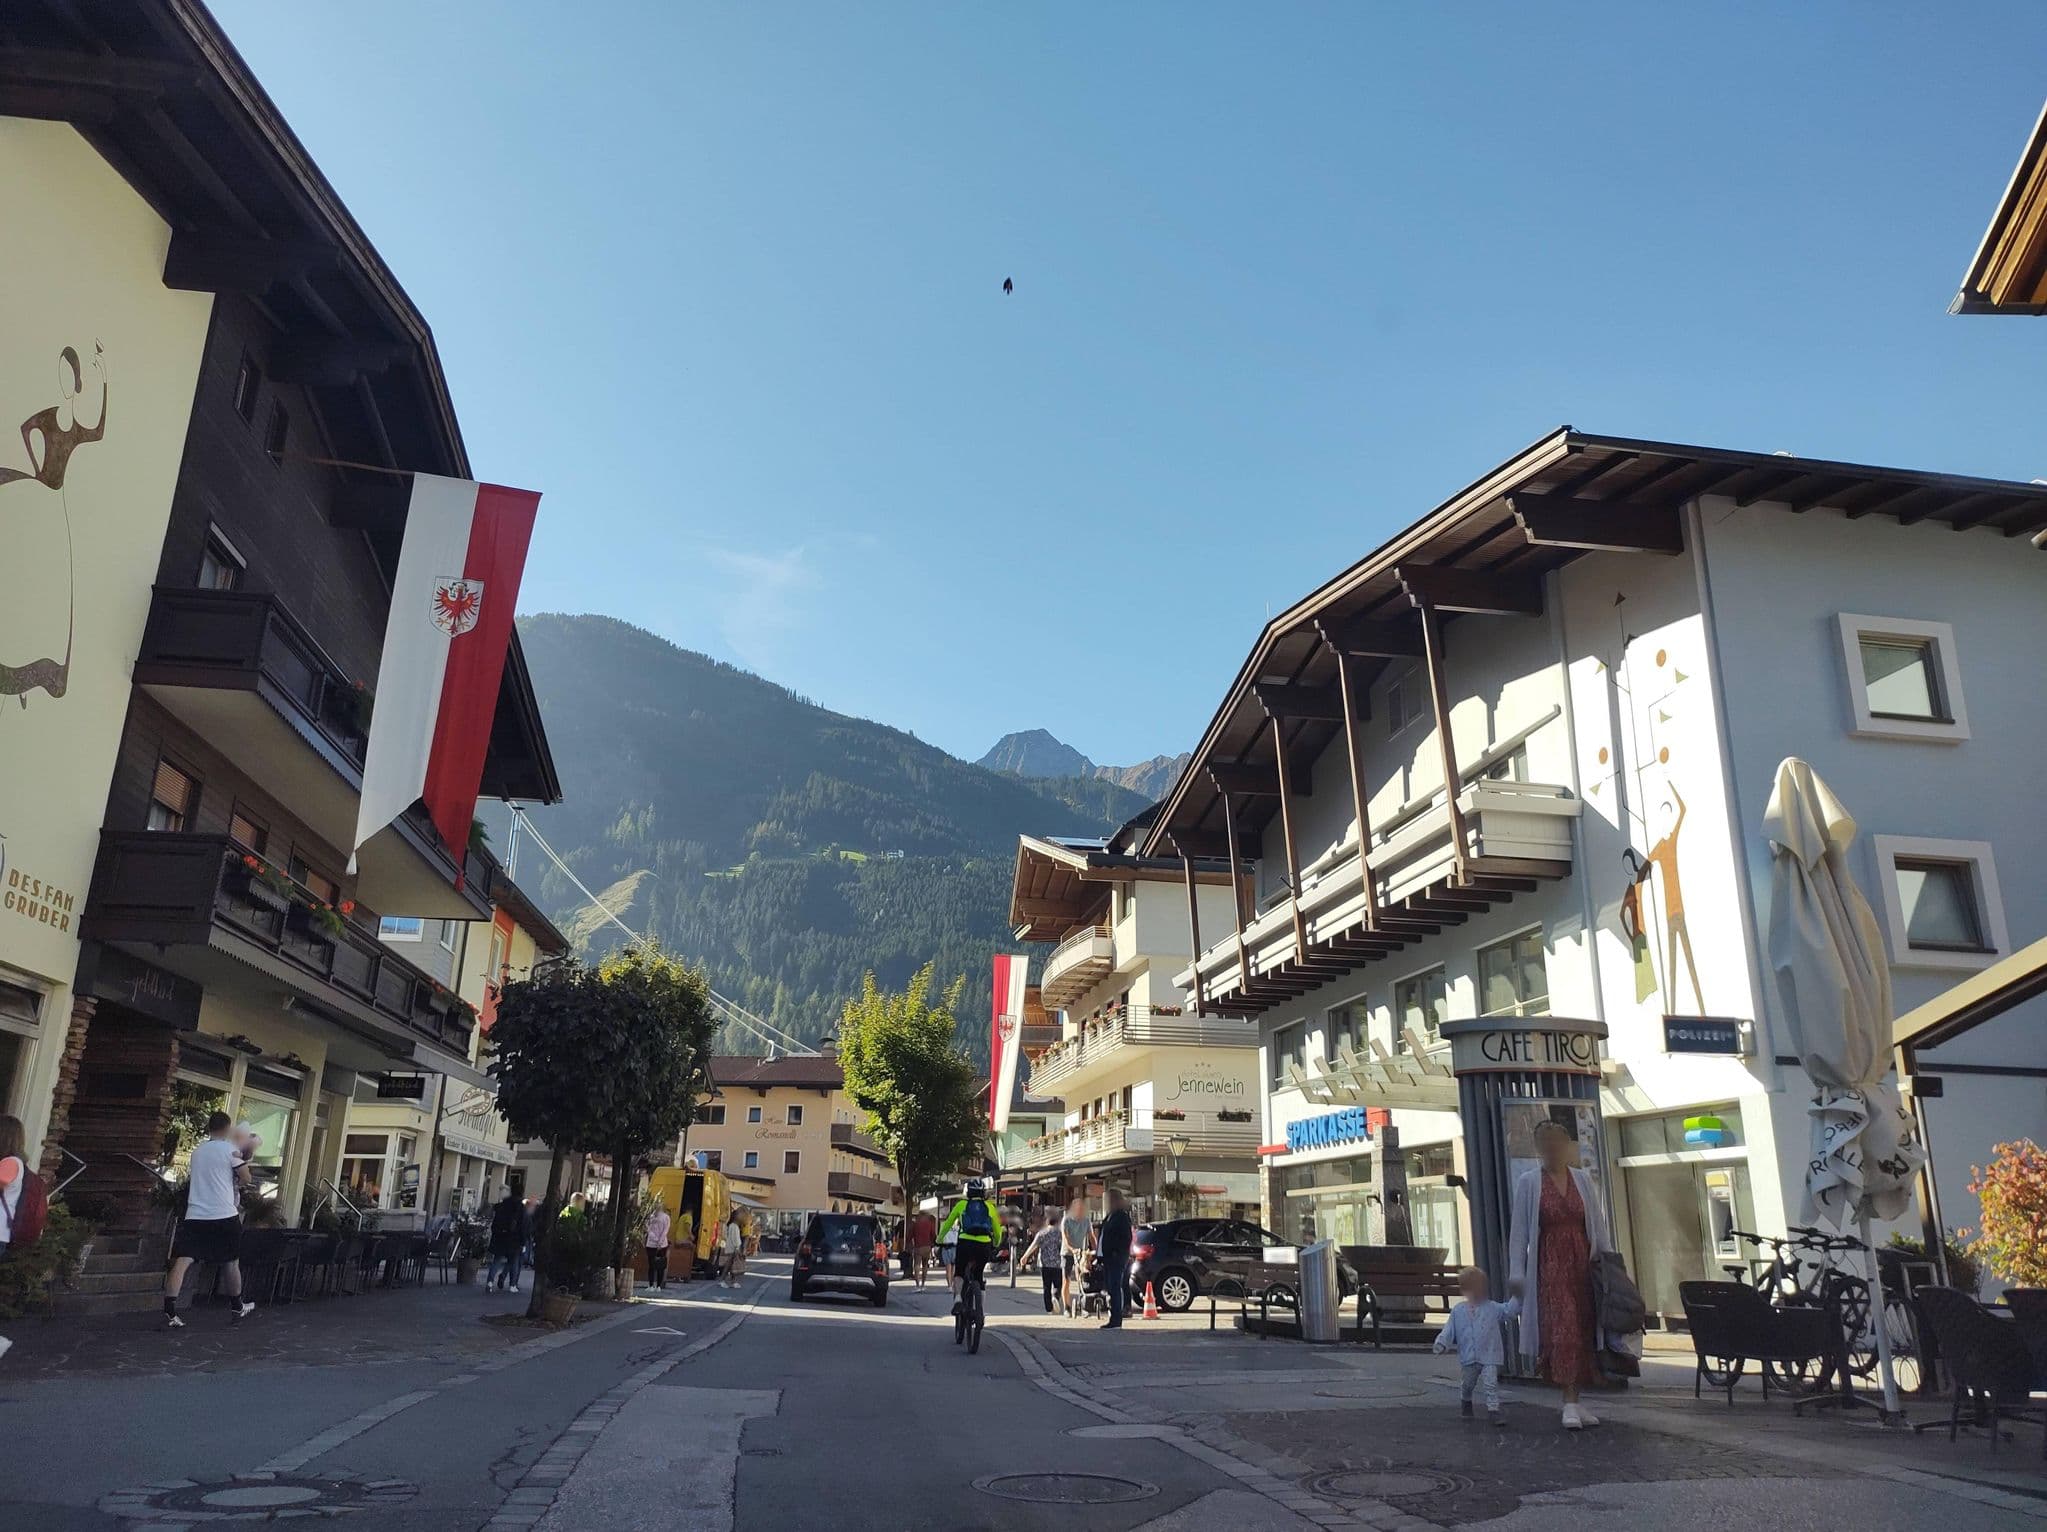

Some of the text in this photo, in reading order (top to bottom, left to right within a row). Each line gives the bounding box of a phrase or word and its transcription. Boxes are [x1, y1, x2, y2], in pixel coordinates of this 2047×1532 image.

[4, 890, 70, 933] GRUBER
[1481, 1031, 1534, 1062] CAFE
[1668, 1025, 1726, 1041] POLIZEI
[1166, 1072, 1244, 1101] Jennewein
[1285, 1106, 1367, 1150] SPARKASSE
